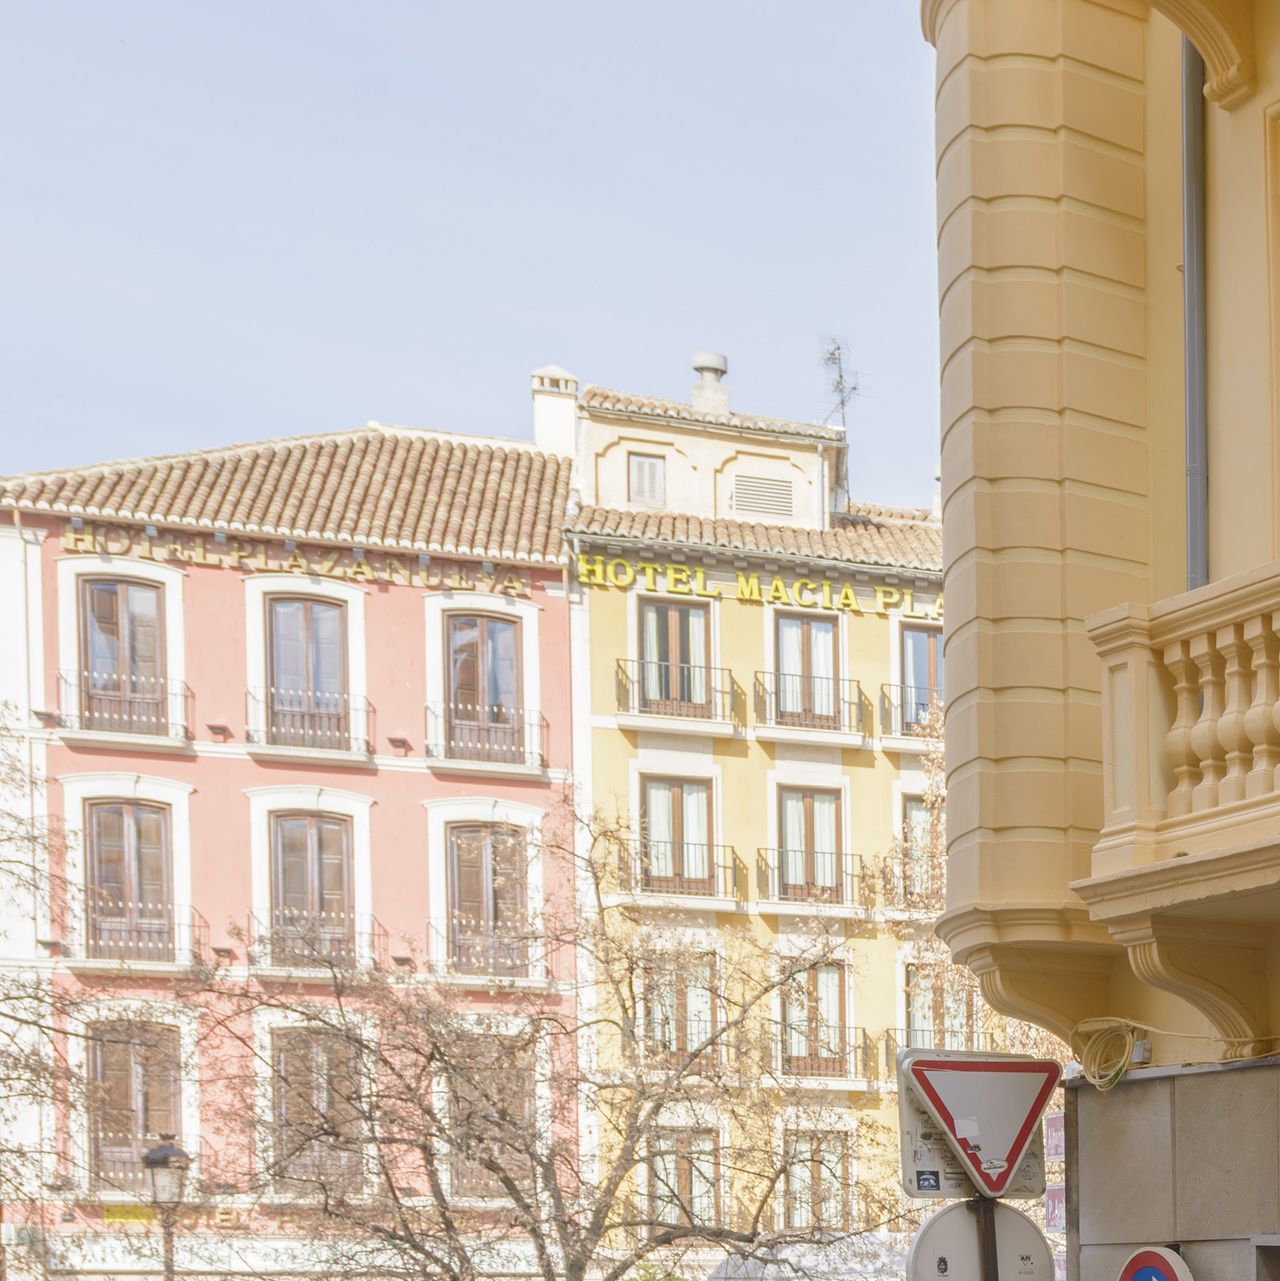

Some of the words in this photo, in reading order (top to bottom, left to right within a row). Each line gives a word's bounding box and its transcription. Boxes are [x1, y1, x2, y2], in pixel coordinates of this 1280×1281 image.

[62, 524, 222, 566] HOTEL
[229, 536, 374, 580] PLAZA
[385, 555, 527, 597] NUEVA
[577, 554, 721, 598] HOTEL
[736, 570, 861, 612] MACIA
